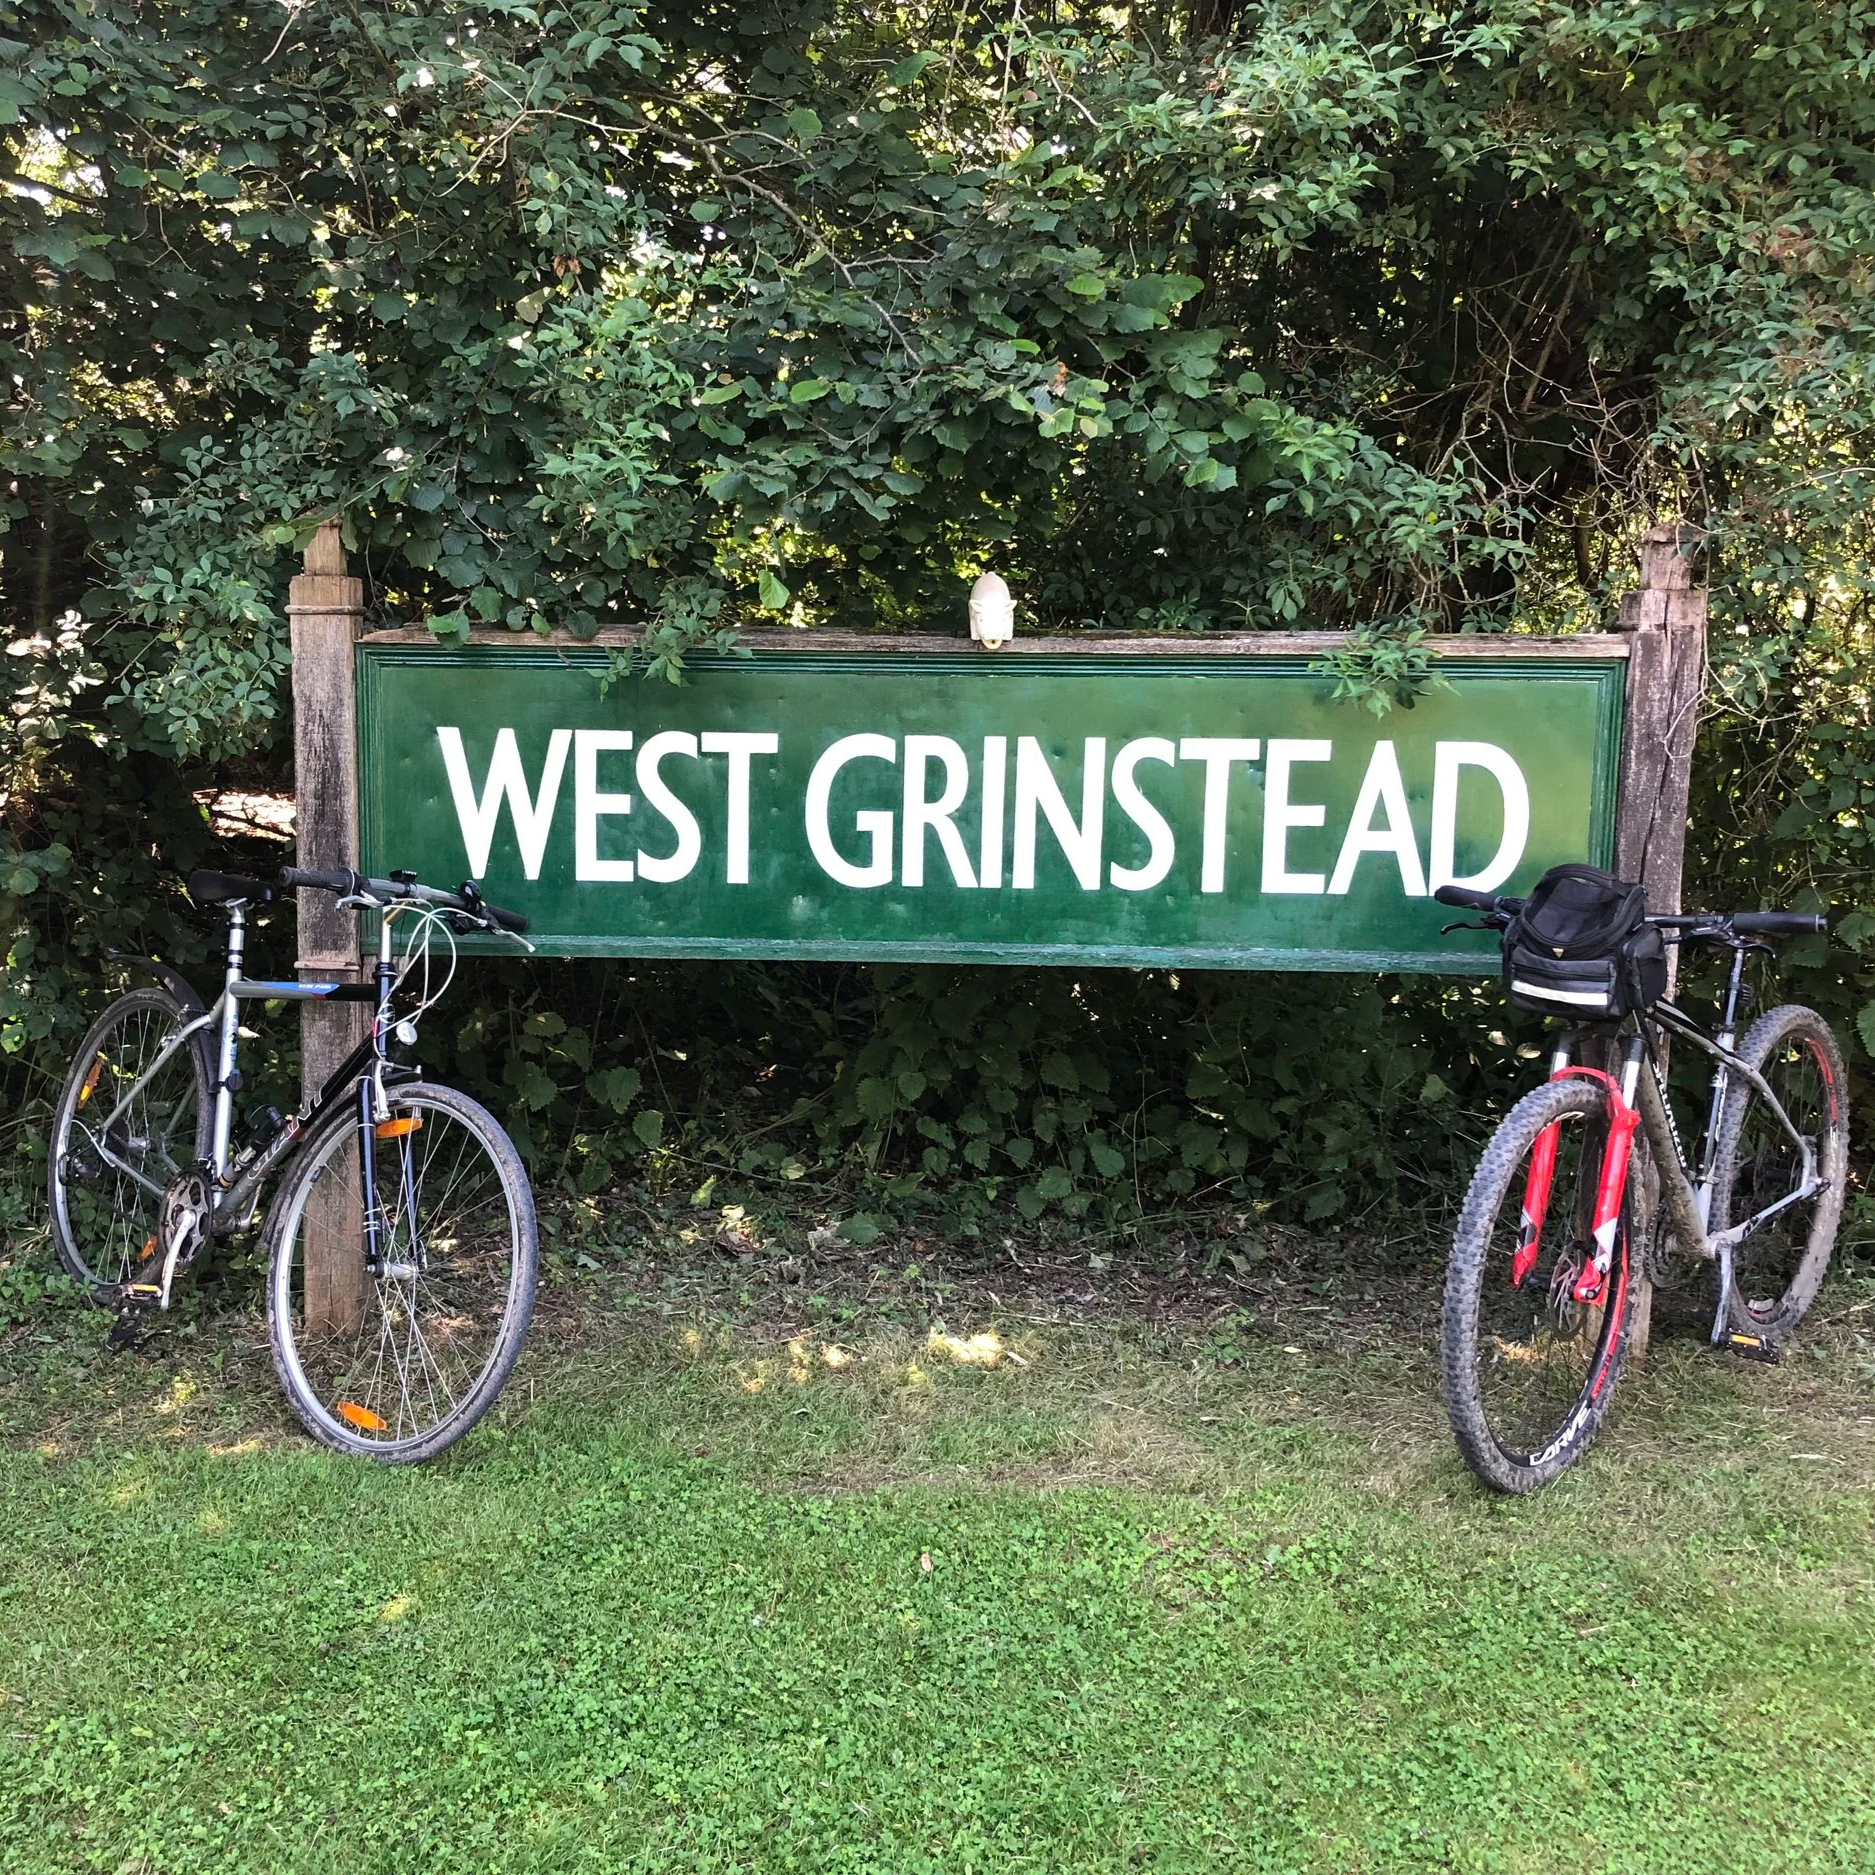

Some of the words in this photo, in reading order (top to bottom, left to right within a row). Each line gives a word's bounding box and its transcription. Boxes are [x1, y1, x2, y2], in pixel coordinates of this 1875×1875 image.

[436, 726, 779, 885] WEST
[805, 733, 1530, 897] GRINSTEAD
[1529, 1399, 1592, 1466] CARVE
